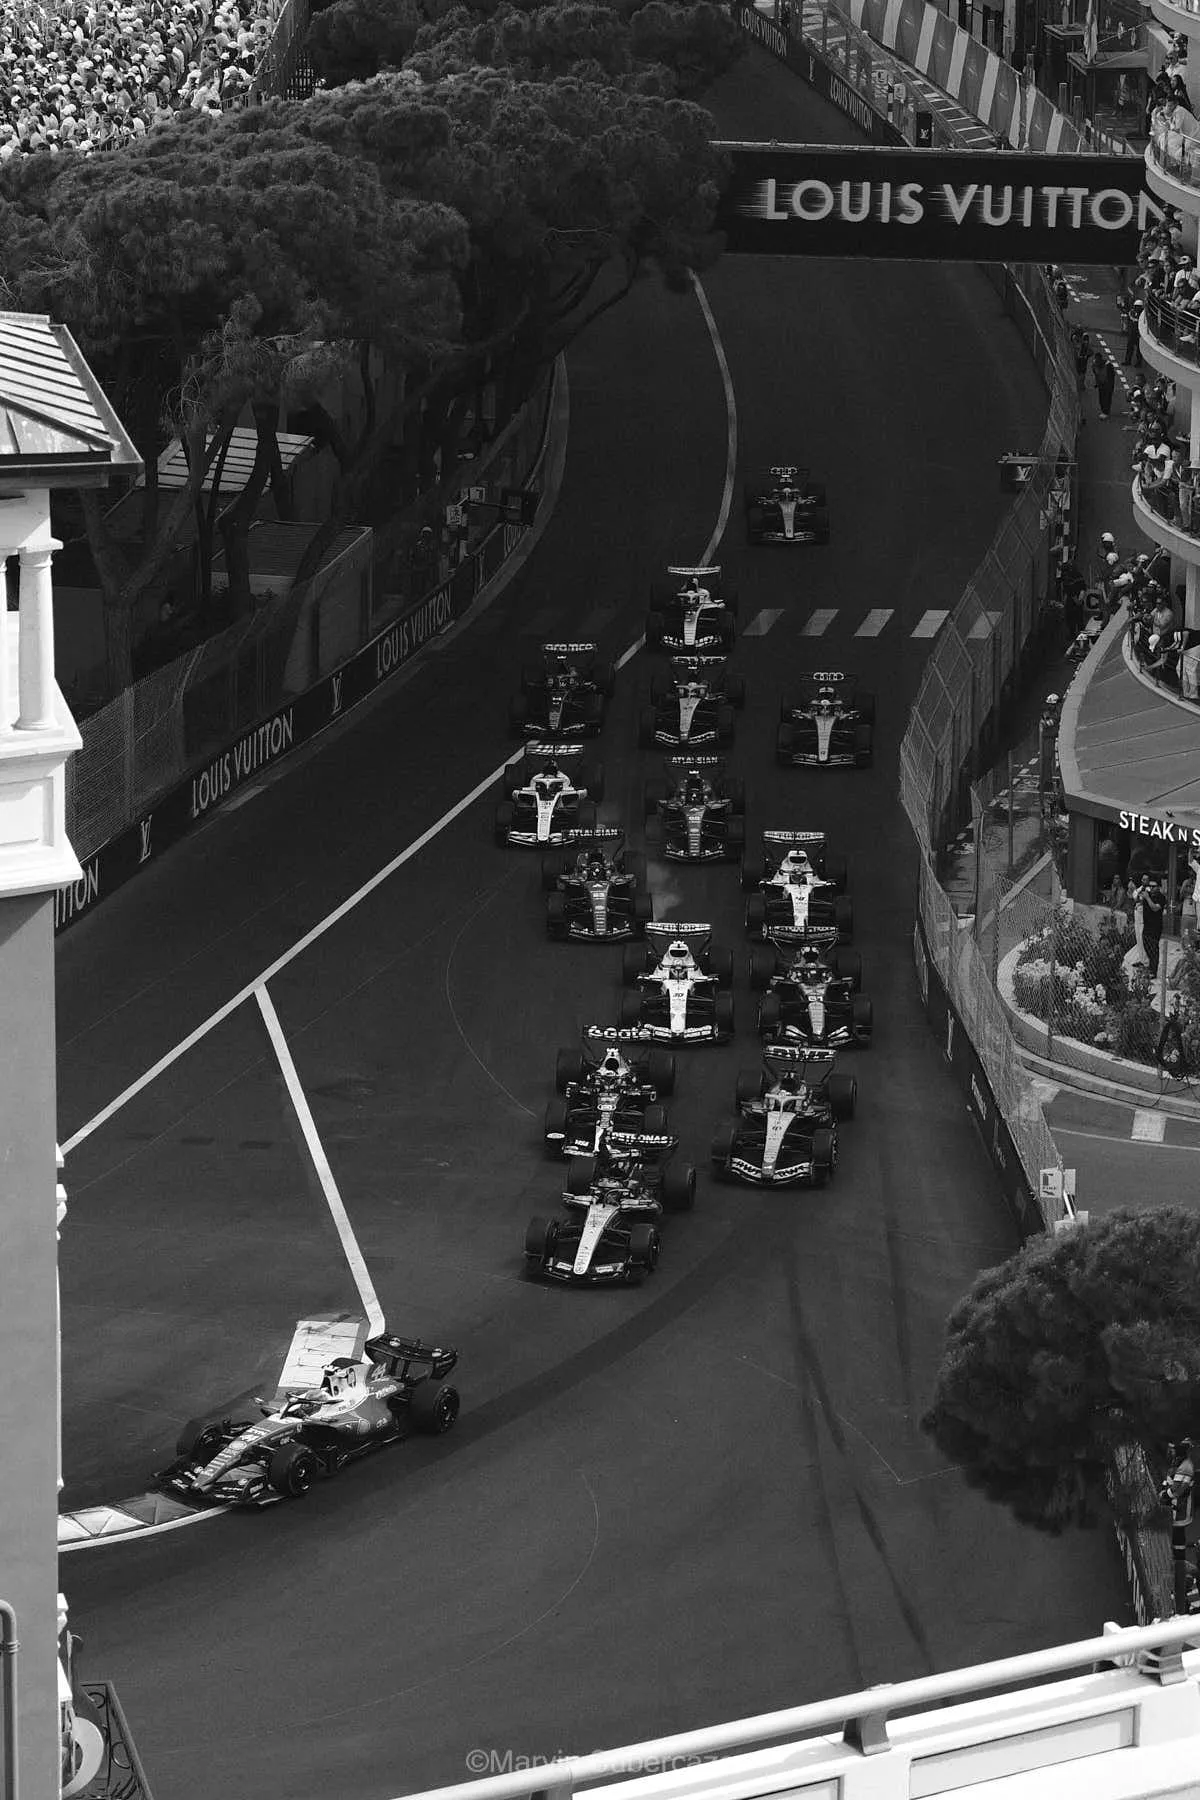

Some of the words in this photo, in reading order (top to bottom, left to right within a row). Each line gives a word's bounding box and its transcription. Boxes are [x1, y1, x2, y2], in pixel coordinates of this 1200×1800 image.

[741, 7, 760, 37] LOUIS
[761, 20, 787, 56] VUITTON
[829, 75, 848, 111] LOUIS
[848, 91, 873, 133] VUITTON
[765, 178, 925, 225] LOUIS
[942, 183, 1167, 231] VUITTON
[376, 621, 409, 679] LOUIS
[410, 583, 451, 648] VUITTON
[544, 642, 594, 652] aramco
[192, 752, 231, 818] LOUIS
[233, 707, 293, 781] VUITTON
[1119, 811, 1175, 842] STEAK
[1178, 828, 1188, 843] N
[611, 1131, 669, 1145] PETRONAS
